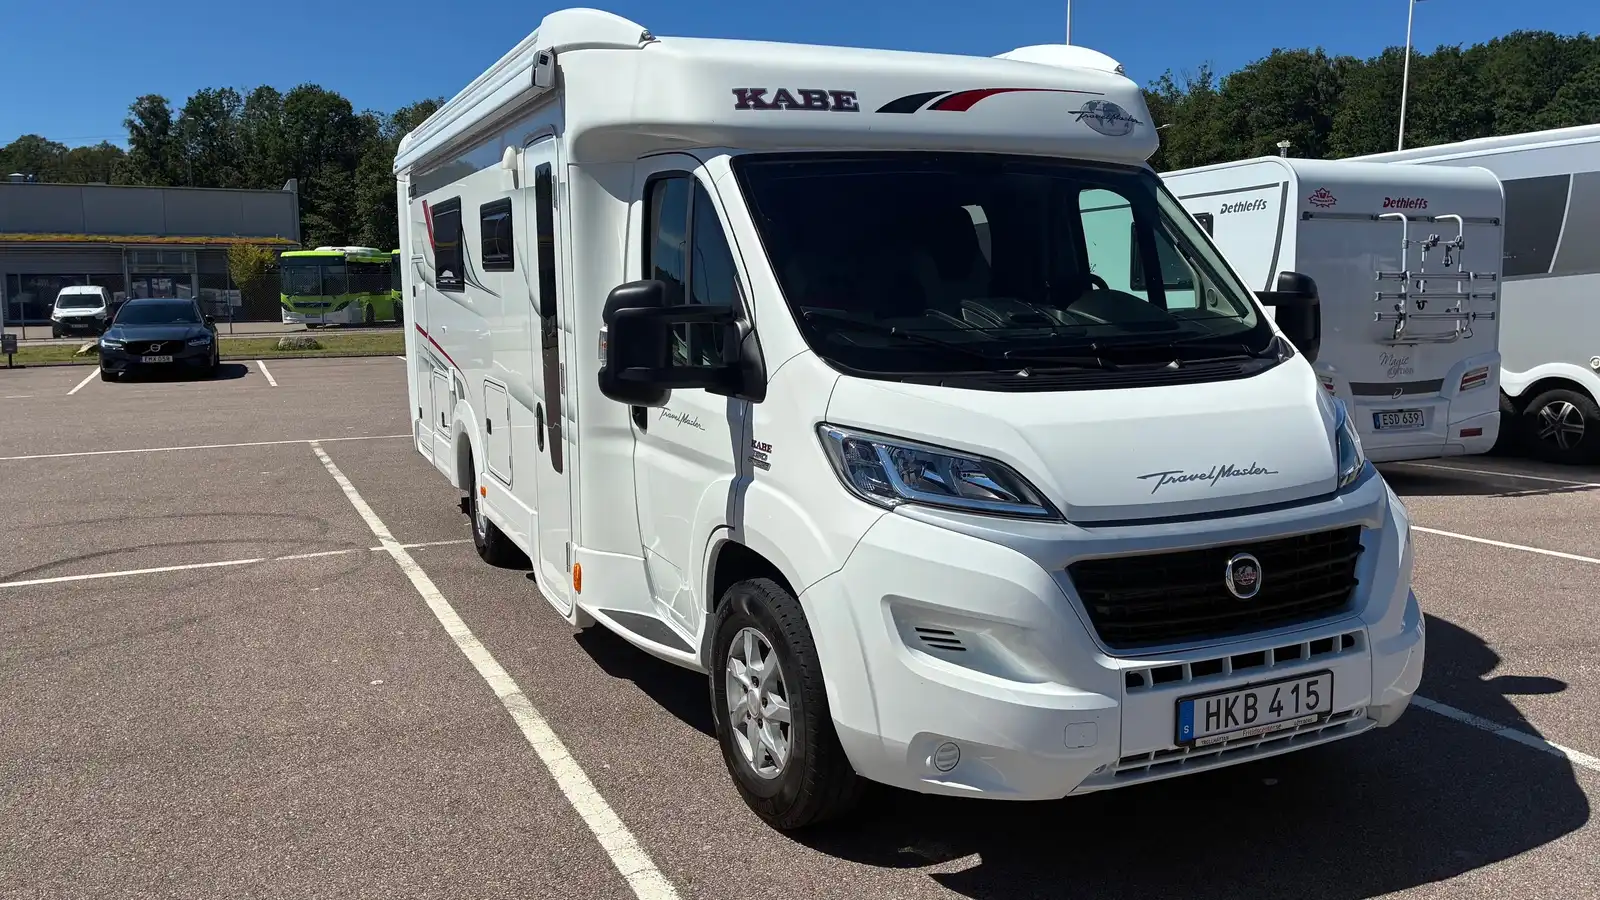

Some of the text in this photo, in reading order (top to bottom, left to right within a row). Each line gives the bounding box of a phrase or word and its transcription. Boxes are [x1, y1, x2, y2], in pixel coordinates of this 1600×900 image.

[731, 87, 860, 113] KABE
[1220, 199, 1267, 214] Dethleffs
[1382, 196, 1428, 209] Dethleffs
[1379, 351, 1409, 374] Magic
[1382, 412, 1419, 425] ESD 639
[751, 439, 772, 453] KABE
[1183, 679, 1320, 734] S HKB 415
